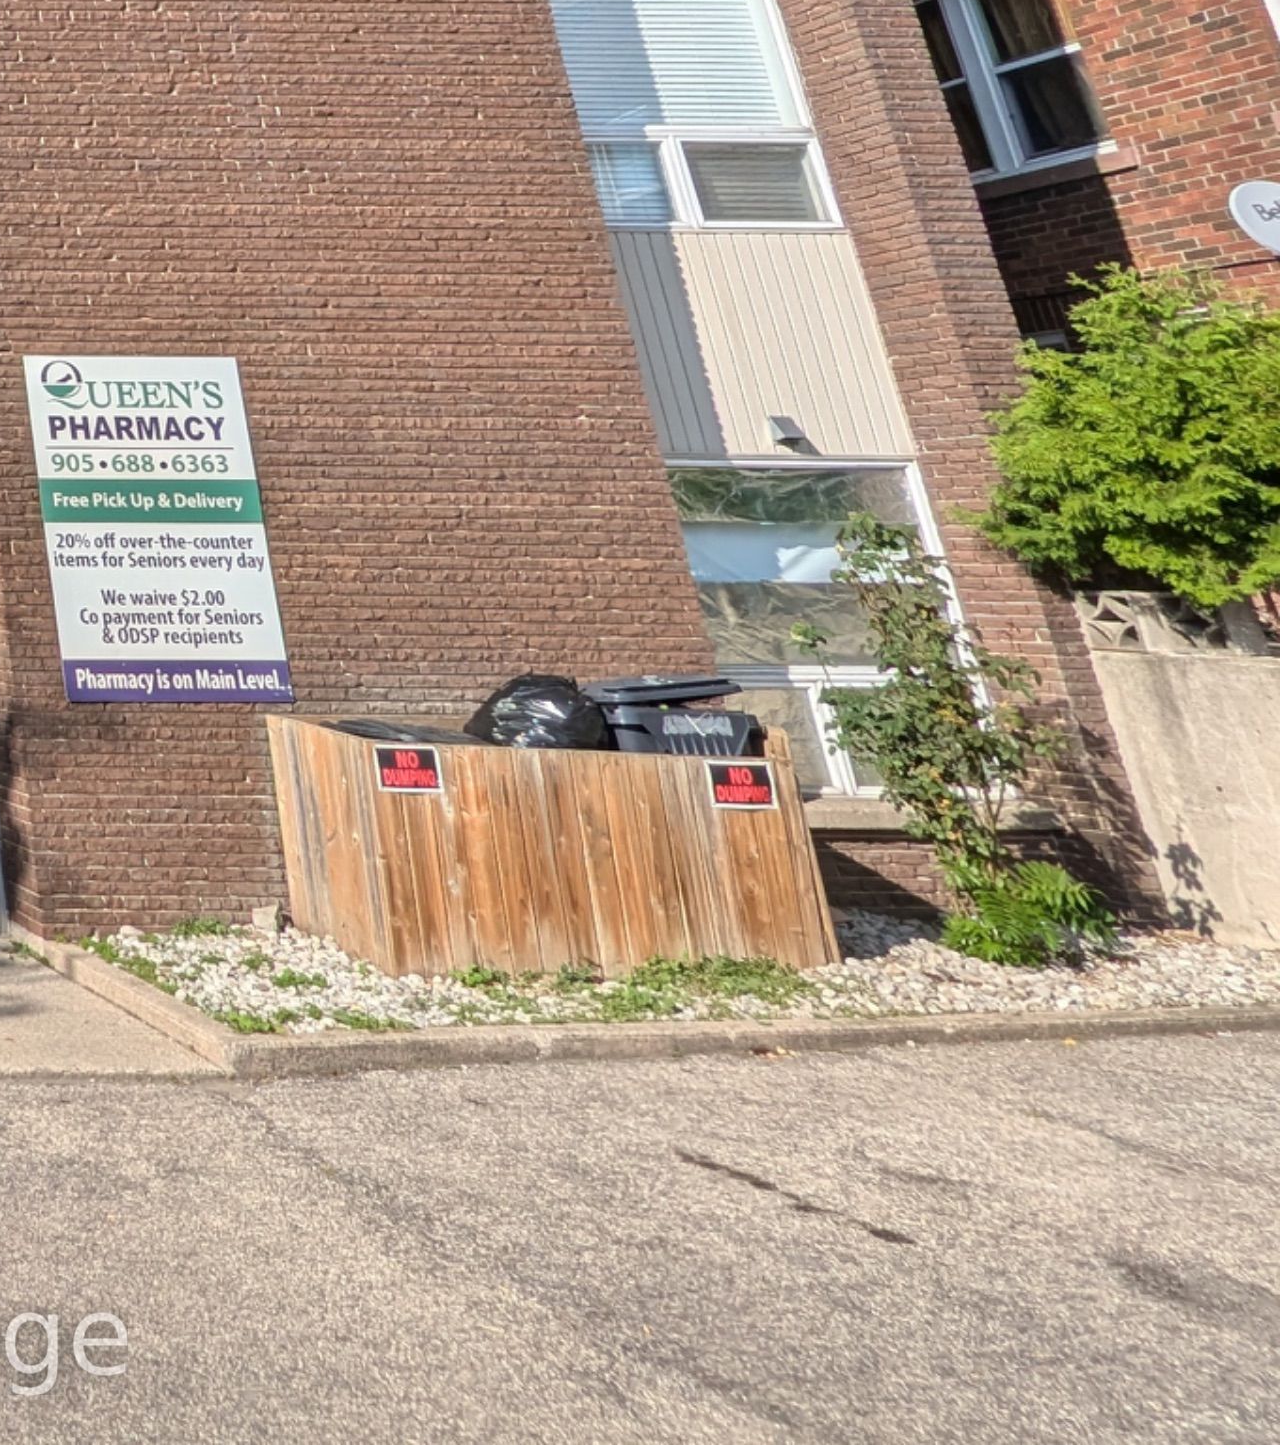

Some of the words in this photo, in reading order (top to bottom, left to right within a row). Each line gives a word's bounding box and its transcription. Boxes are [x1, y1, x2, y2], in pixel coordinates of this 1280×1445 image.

[41, 360, 224, 410] QUEEN'S
[48, 415, 225, 441] PHARMACY
[52, 492, 89, 507] Free
[92, 492, 127, 508] Pick
[130, 493, 154, 511] Up
[157, 493, 171, 508] &
[173, 493, 243, 512] Delivery
[55, 533, 90, 548] 20%
[94, 532, 116, 549] off
[120, 533, 253, 550] over-the-counter
[54, 551, 98, 567] items
[101, 551, 123, 567] for
[128, 552, 187, 568] Seniors
[190, 556, 233, 571] every
[236, 552, 265, 571] day
[101, 589, 126, 605] We
[129, 590, 177, 606] waive
[181, 589, 225, 607] $2.00
[80, 608, 98, 624] Co
[103, 610, 175, 631] payment
[177, 609, 200, 625] for
[204, 609, 264, 625] Seniors
[102, 627, 114, 644] &
[118, 627, 159, 644] ODSP
[164, 628, 244, 648] recipients
[75, 668, 154, 694] Pharmacy
[156, 669, 170, 689] is
[172, 673, 193, 689] on
[195, 669, 236, 689] Main
[394, 750, 419, 769] NO
[382, 768, 436, 786] DUMPING
[728, 766, 753, 785] NO
[715, 784, 770, 803] DUMPING
